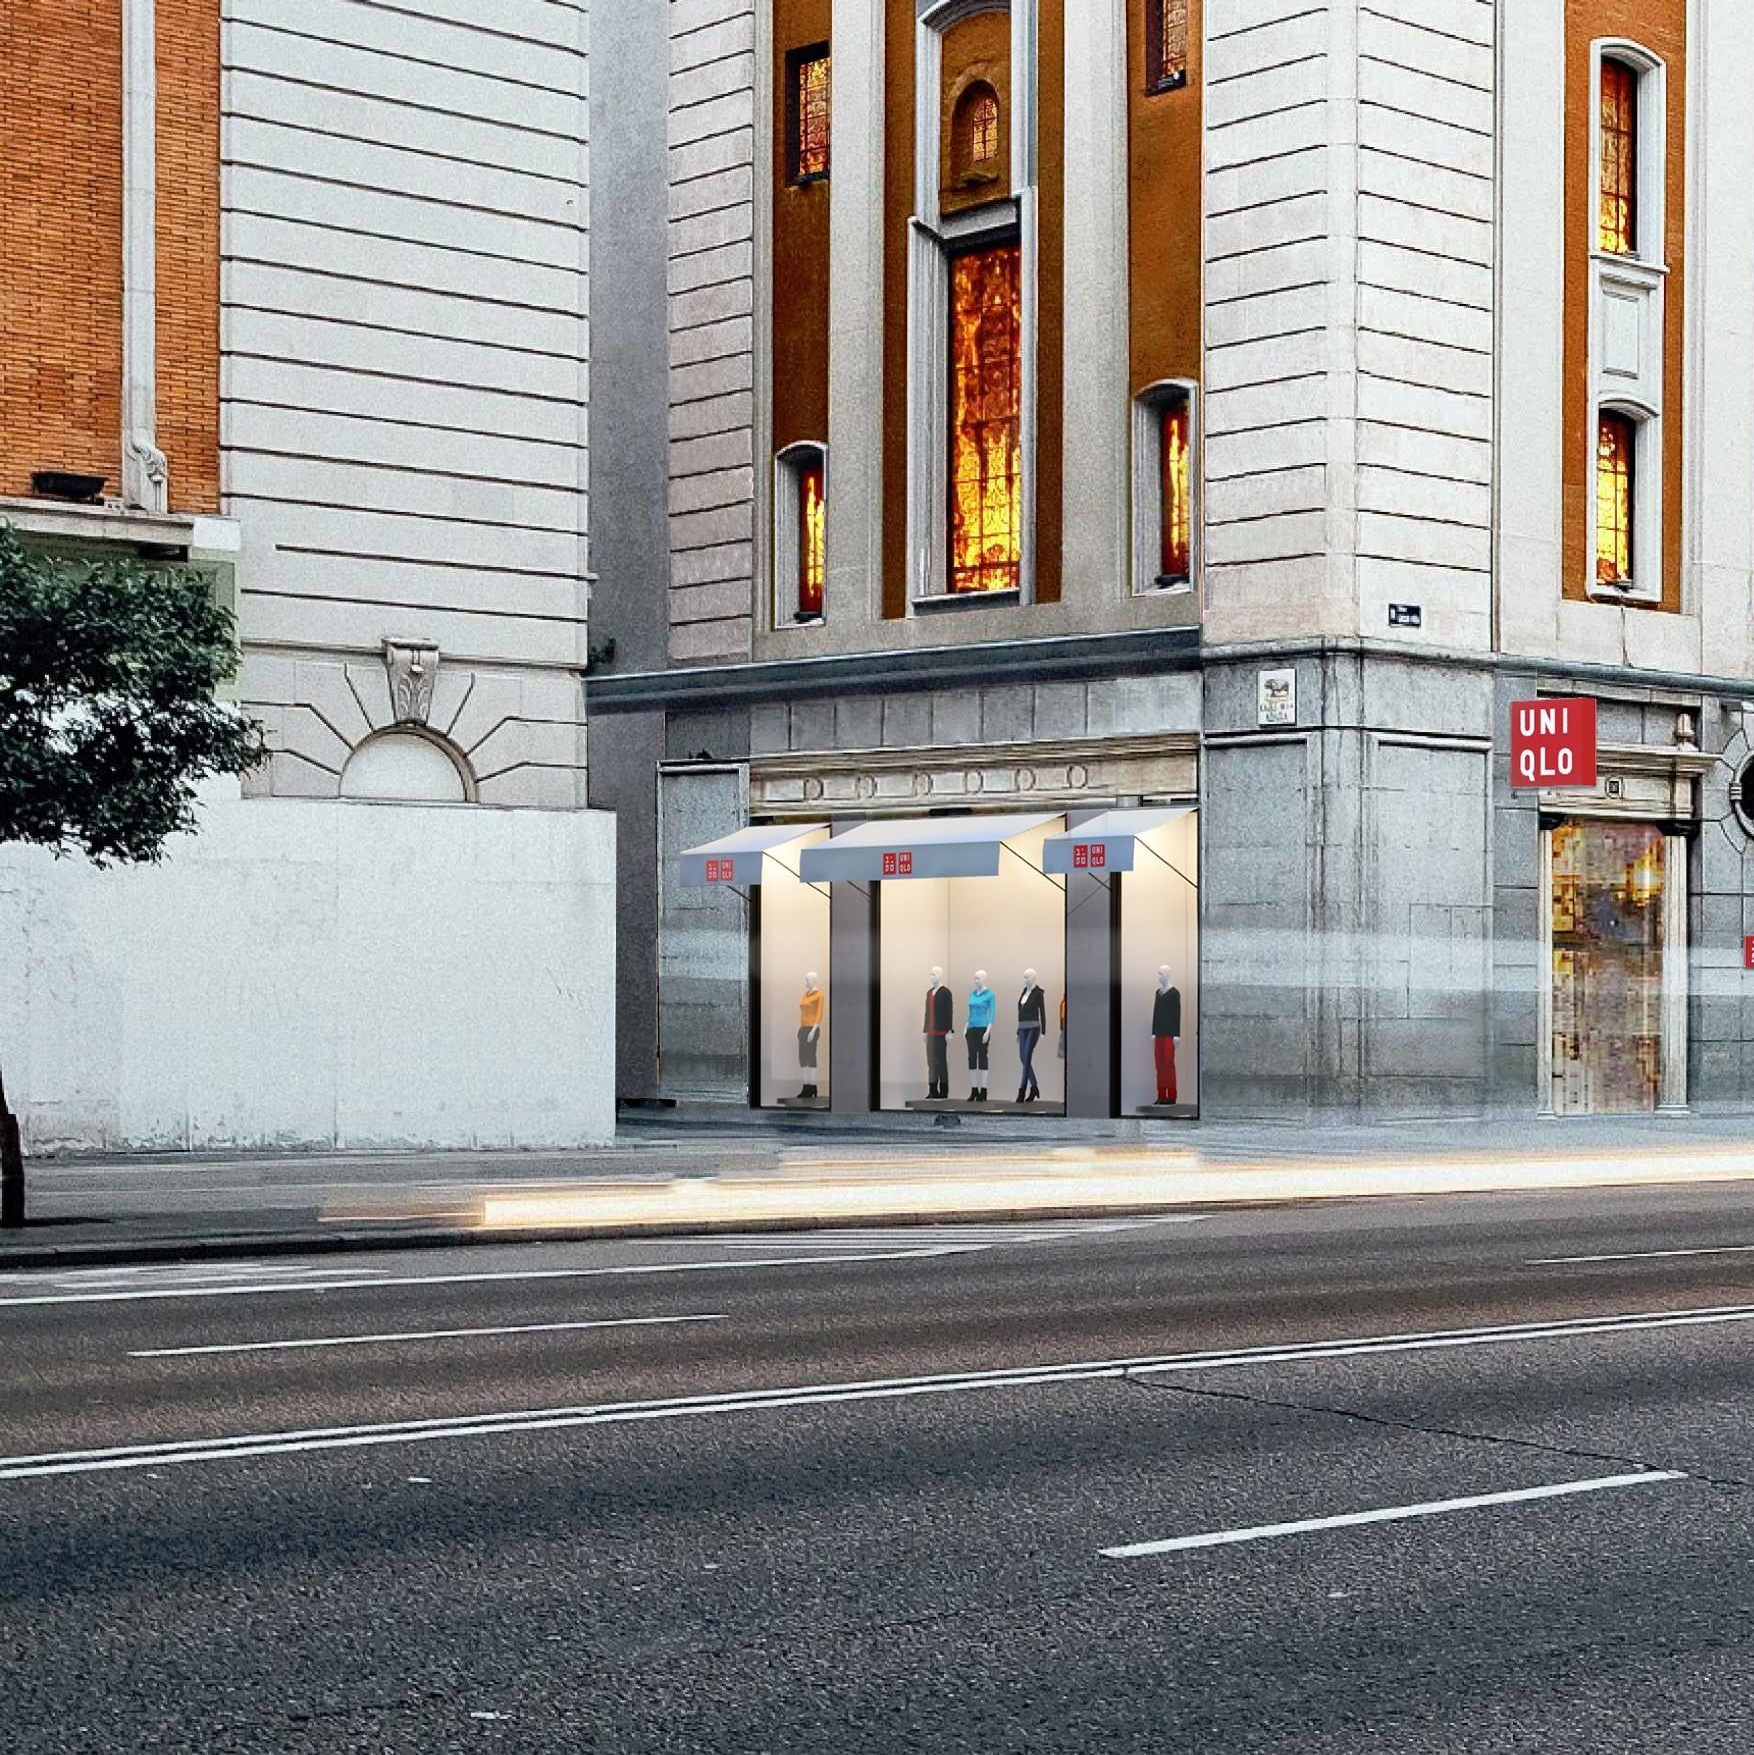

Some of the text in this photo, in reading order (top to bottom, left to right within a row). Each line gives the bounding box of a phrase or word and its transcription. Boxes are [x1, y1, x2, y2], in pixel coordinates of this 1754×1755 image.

[1520, 707, 1568, 737] UNI
[1520, 746, 1573, 782] QLO
[1092, 846, 1103, 854] UNI
[1092, 857, 1104, 865] QLO
